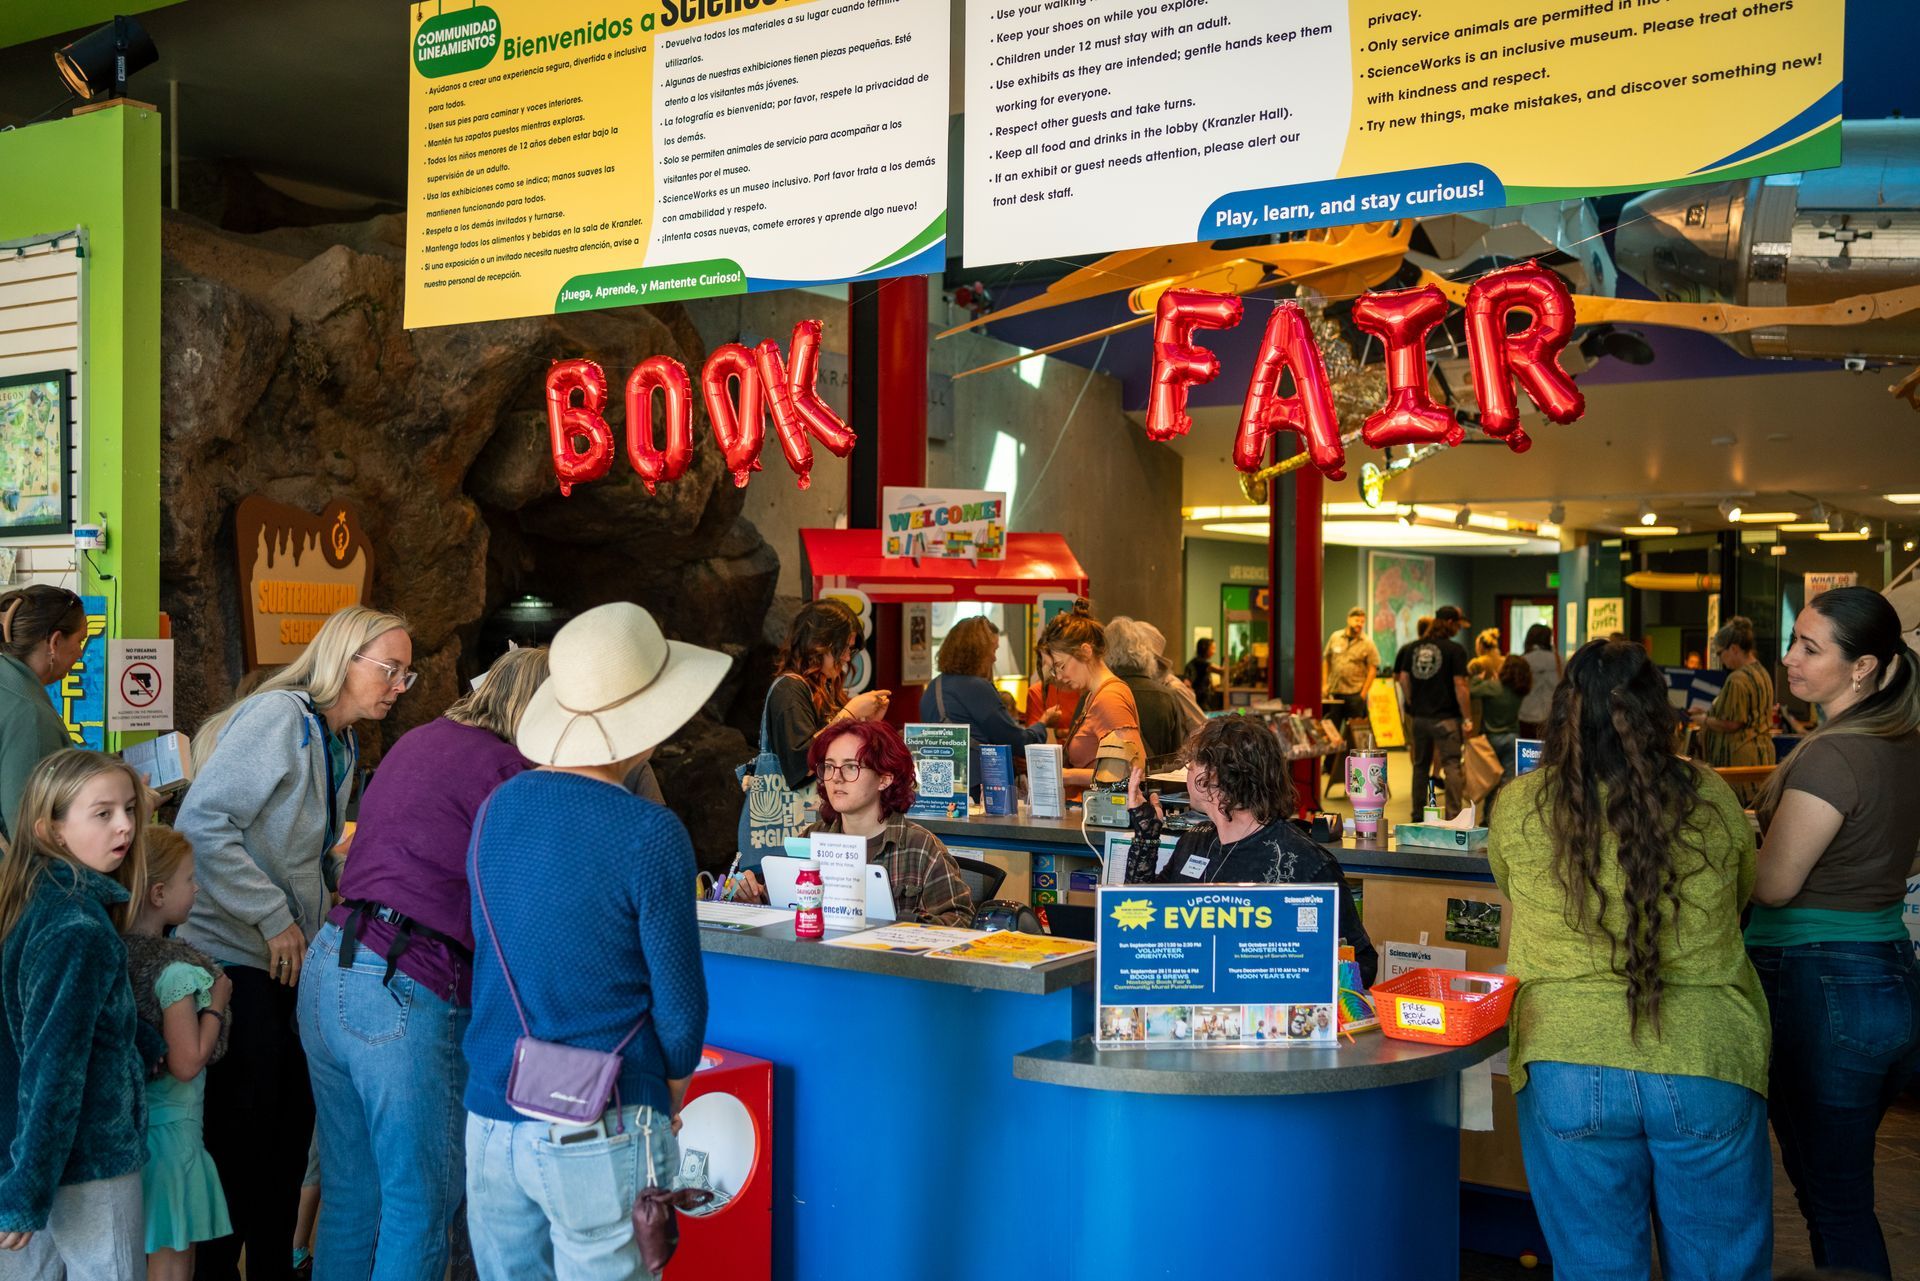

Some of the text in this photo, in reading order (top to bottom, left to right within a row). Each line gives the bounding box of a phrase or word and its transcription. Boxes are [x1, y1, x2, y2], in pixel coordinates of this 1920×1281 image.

[418, 18, 496, 46] COMMUNIDAD
[504, 18, 632, 60] Bienvenidos
[640, 13, 655, 30] a
[996, 0, 1208, 43] Keep your shoes on while you explore.
[1367, 0, 1613, 52] Only service animals are permitted
[1367, 0, 1793, 78] ScienceWorks is an inclusive museum. Please treat others
[1368, 9, 1421, 28] privacy.
[418, 34, 496, 62] LINEAMIENTOS
[996, 15, 1231, 66] Children under 12 must stay with an adult.
[996, 24, 1332, 90] Use exhibits as they are intended; gentle hands keep them
[428, 82, 461, 95] Ayúdanos
[468, 77, 486, 87] crear
[488, 75, 501, 83] una
[502, 65, 544, 80] experiencia
[545, 61, 572, 72] segura,
[573, 53, 606, 66] divertida
[614, 45, 646, 58] inclusiva
[1367, 67, 1550, 105] with kindness and respect.
[1366, 52, 1822, 132] Try new things, make mistakes, and discover something new!
[662, 189, 717, 204] ScienceWorks
[742, 182, 770, 192] museo
[771, 176, 811, 188] inclusivo.
[813, 171, 830, 182] Port
[832, 170, 855, 179] favor
[856, 165, 878, 176] trata
[889, 162, 902, 171] los
[904, 156, 936, 169] demás
[1216, 179, 1484, 228] Play, learn, and stay curious!
[561, 271, 741, 302] ¡Juega, Aprende, y Mantente Curioso!
[546, 258, 1585, 497] BOOK FAIR
[889, 500, 1002, 532] WELCOME!
[1164, 906, 1272, 928] EVENTS
[1187, 895, 1251, 906] UPCOMING
[1284, 895, 1323, 903] ScienceWorks
[1390, 949, 1431, 960] ScienceWorks
